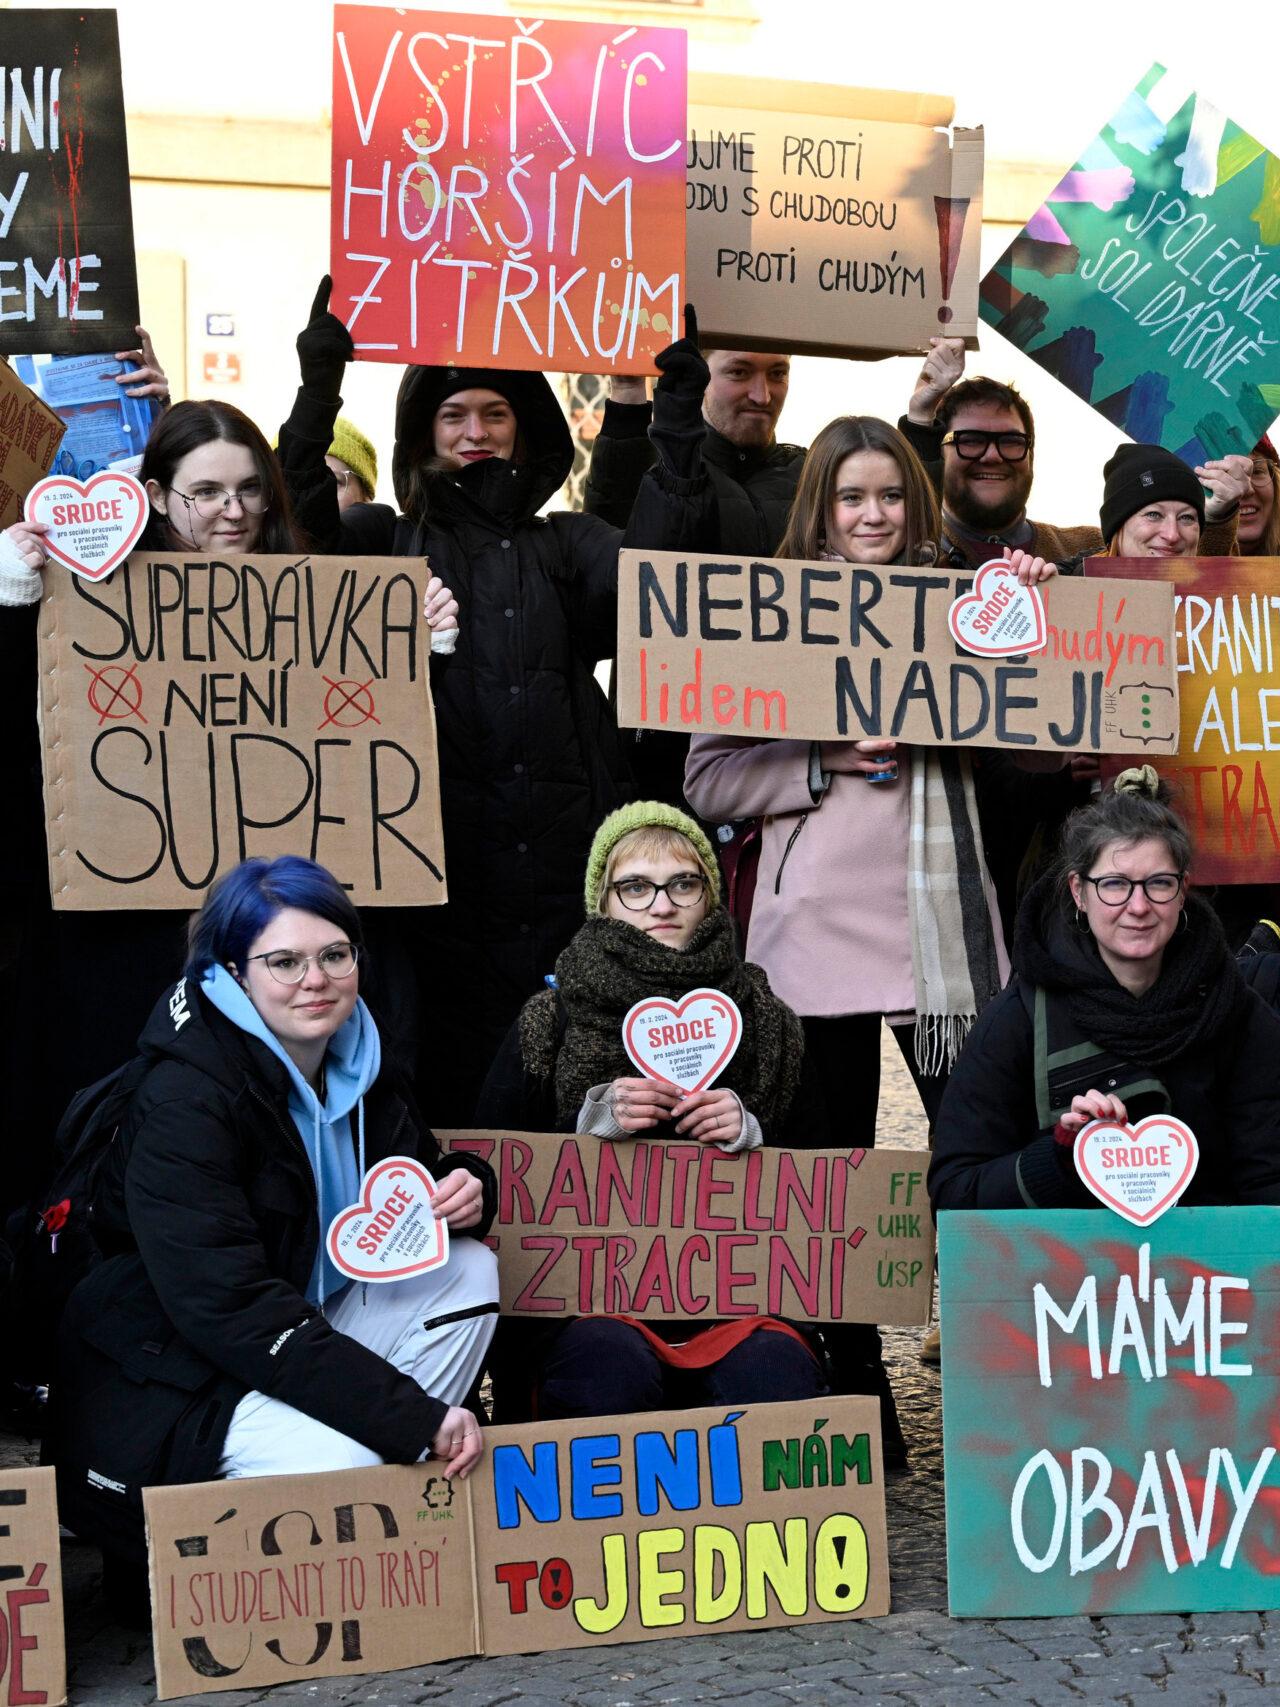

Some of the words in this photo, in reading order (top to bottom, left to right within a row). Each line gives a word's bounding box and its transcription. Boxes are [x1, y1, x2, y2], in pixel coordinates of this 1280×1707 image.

[0, 66, 62, 153] NI
[337, 18, 682, 163] VSTŘÍC
[783, 132, 863, 181] PROTI
[343, 154, 632, 260] HORŠÍM
[741, 187, 759, 216] S
[770, 190, 897, 230] CHUDOBOU
[345, 241, 680, 365] ZÍTŘKŮM
[717, 247, 796, 284] PROTI
[819, 251, 926, 299] CHUDÝM
[1080, 238, 1279, 397] SOLIDÁRNĚ
[52, 499, 123, 526] SRDCE
[71, 556, 419, 683] SUPERDÁVKA
[972, 582, 1016, 635] SRDCE
[1027, 584, 1165, 688] hudým
[164, 658, 293, 728] NENÍ
[638, 647, 787, 732] lidem
[75, 726, 444, 890] SUPER
[648, 1017, 716, 1048] SRDCE
[889, 1172, 922, 1206] FF
[1101, 1146, 1171, 1168] SRDCE
[356, 1184, 414, 1255] SRDCE
[877, 1214, 921, 1238] UHK
[512, 1227, 868, 1320] ZTRACENÍ
[1033, 1242, 1252, 1388] MÁME
[493, 1411, 748, 1529] NENÍ
[763, 1419, 872, 1491] NÁM
[1010, 1446, 1277, 1576] OBAVY
[170, 1575, 176, 1629] I
[189, 1561, 325, 1627] STUDENTY
[337, 1556, 366, 1614] TO
